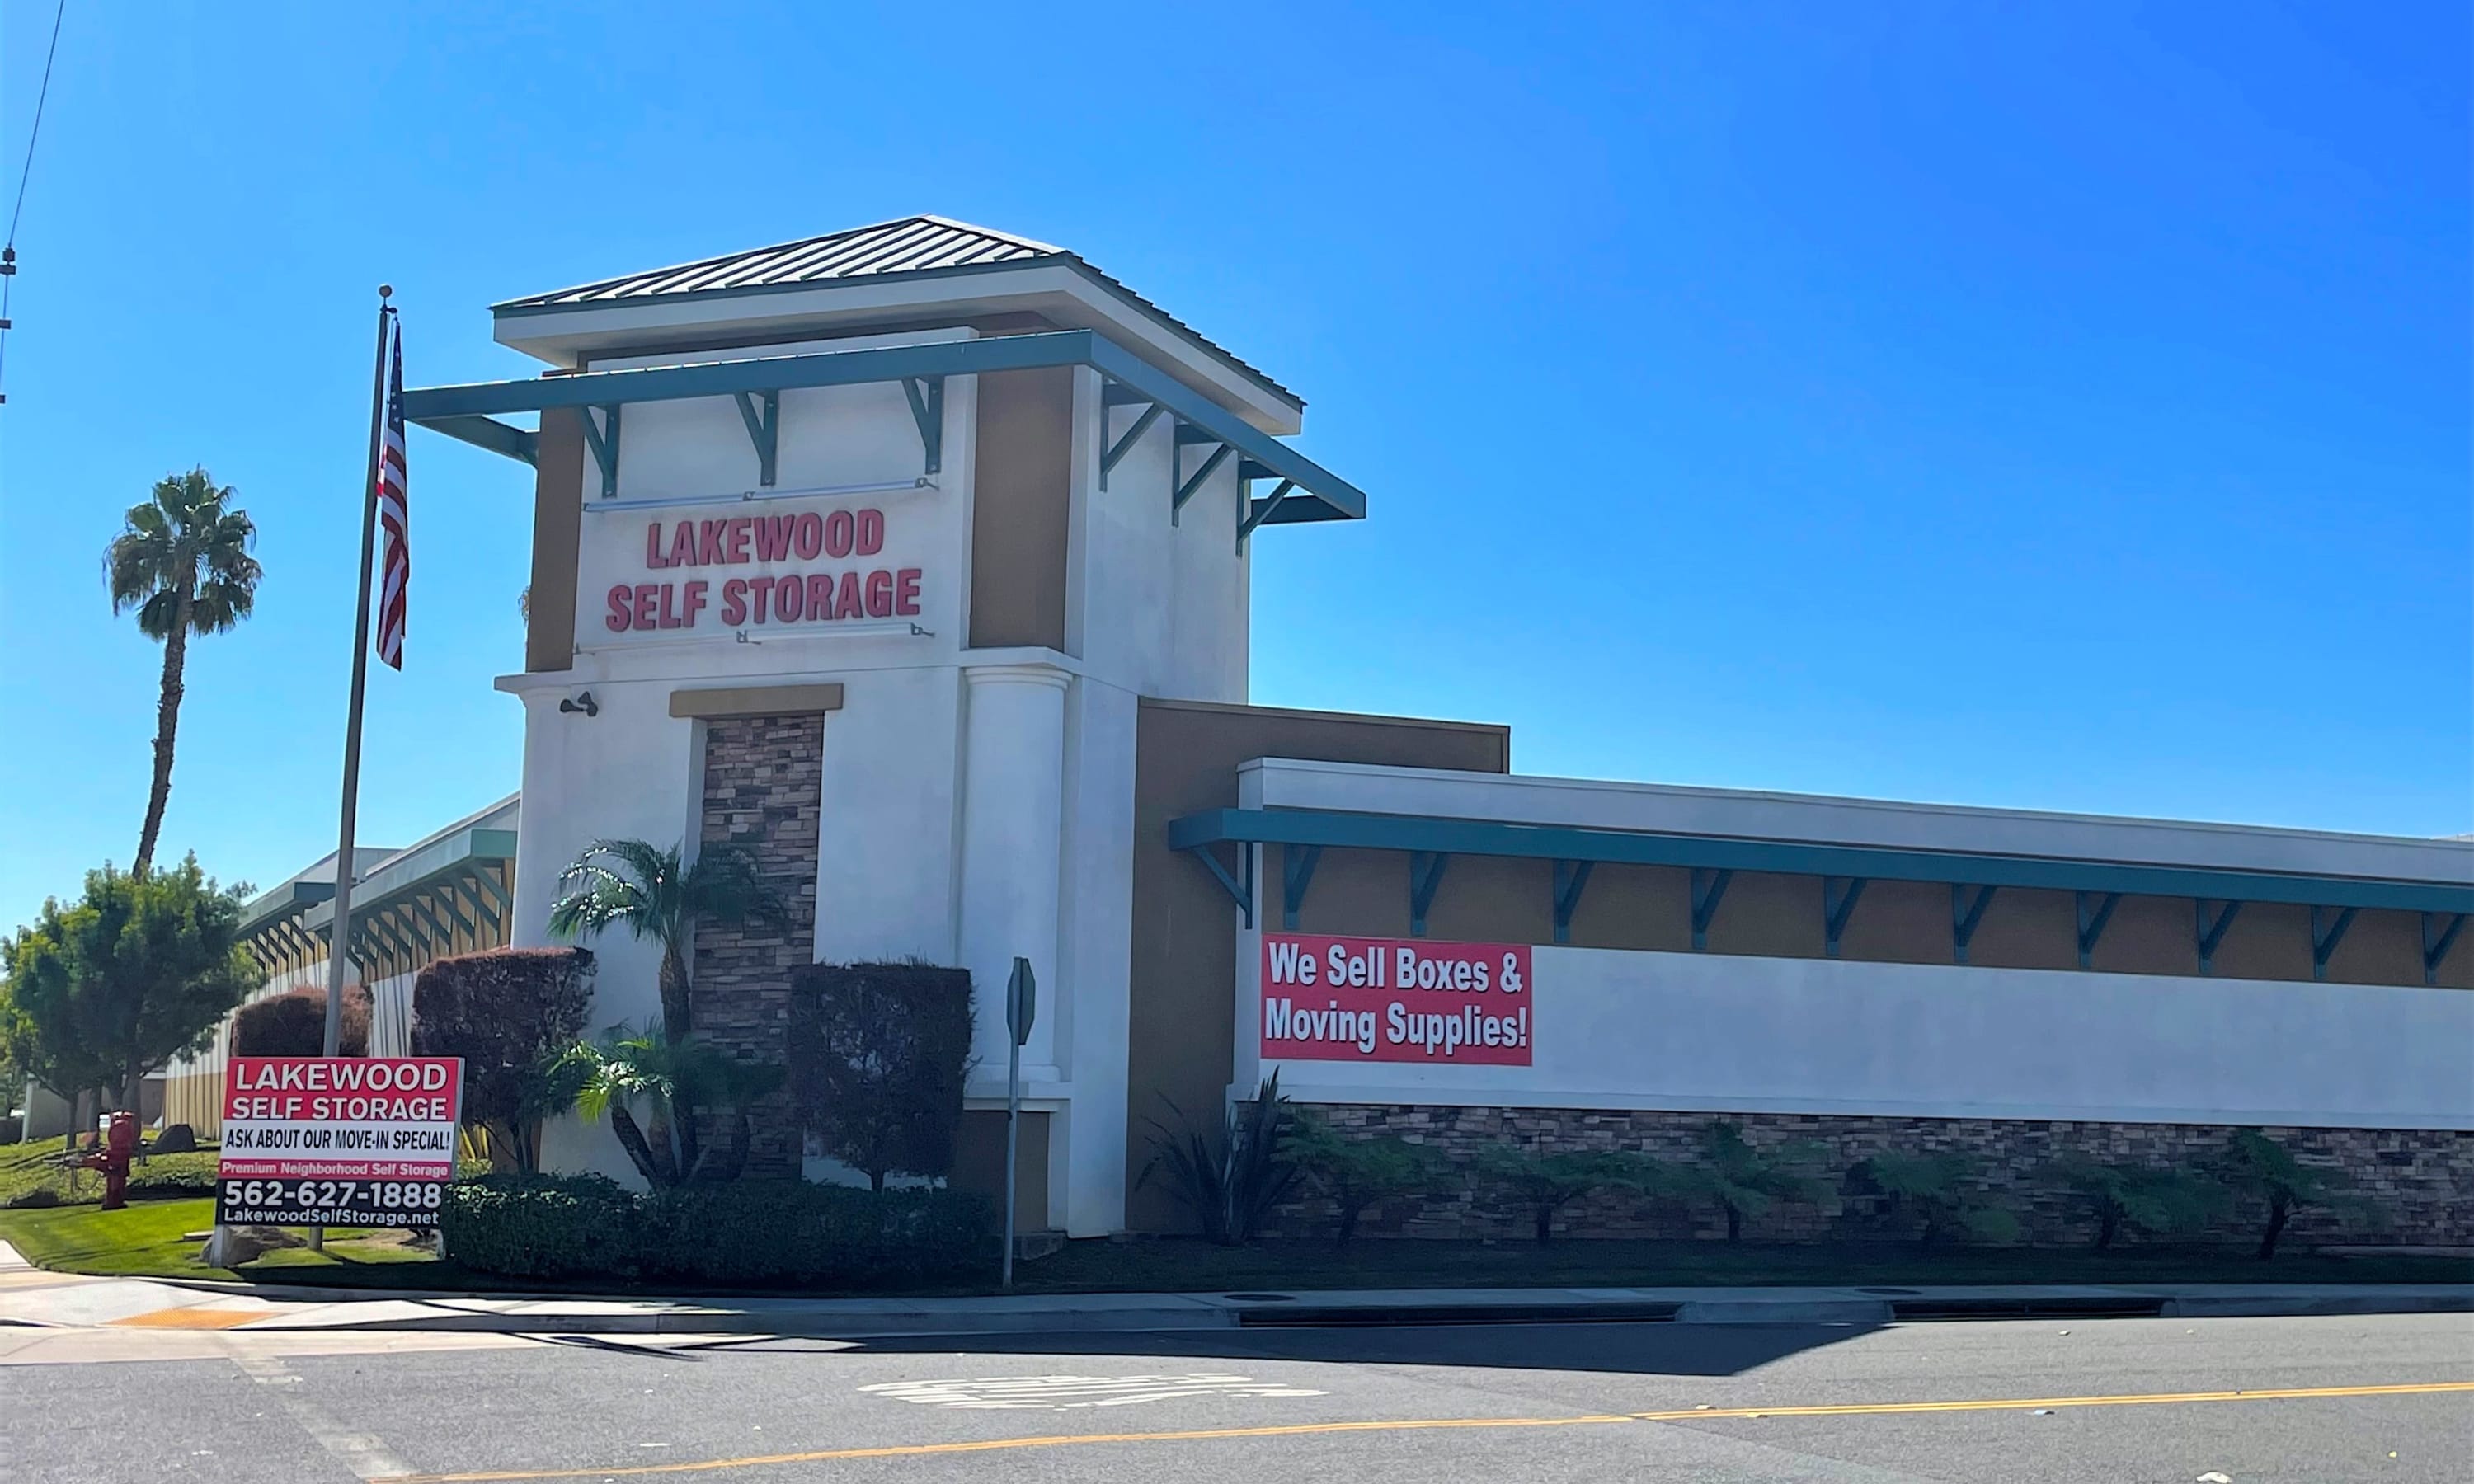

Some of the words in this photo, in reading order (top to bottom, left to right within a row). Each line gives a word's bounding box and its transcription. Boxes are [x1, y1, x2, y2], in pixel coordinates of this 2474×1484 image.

[647, 509, 884, 569] LAKEWOOD
[605, 580, 708, 632] SELF
[721, 568, 923, 627] STORAGE
[1268, 942, 1317, 985] We
[1327, 944, 1385, 988] Sell
[1395, 948, 1489, 993] Boxes
[1499, 952, 1523, 993] &
[1265, 998, 1376, 1054] Moving
[1386, 1002, 1527, 1055] Supplies!
[235, 1063, 448, 1092] LAKEWOOD
[231, 1097, 303, 1120] SELF
[311, 1097, 447, 1121] STORAGE
[225, 1129, 253, 1148] ASK
[256, 1129, 299, 1149] ABOUT
[303, 1129, 331, 1149] OUR
[335, 1130, 389, 1151] MOVE-IN
[393, 1130, 450, 1151] SPECIAL!
[222, 1162, 276, 1175] Premium
[280, 1162, 368, 1177] Neighborhood
[371, 1163, 397, 1176] Self
[400, 1164, 448, 1178] Storage
[223, 1181, 442, 1209] 562-627-1888
[223, 1208, 440, 1225] LakewoodSelfStorage.net
